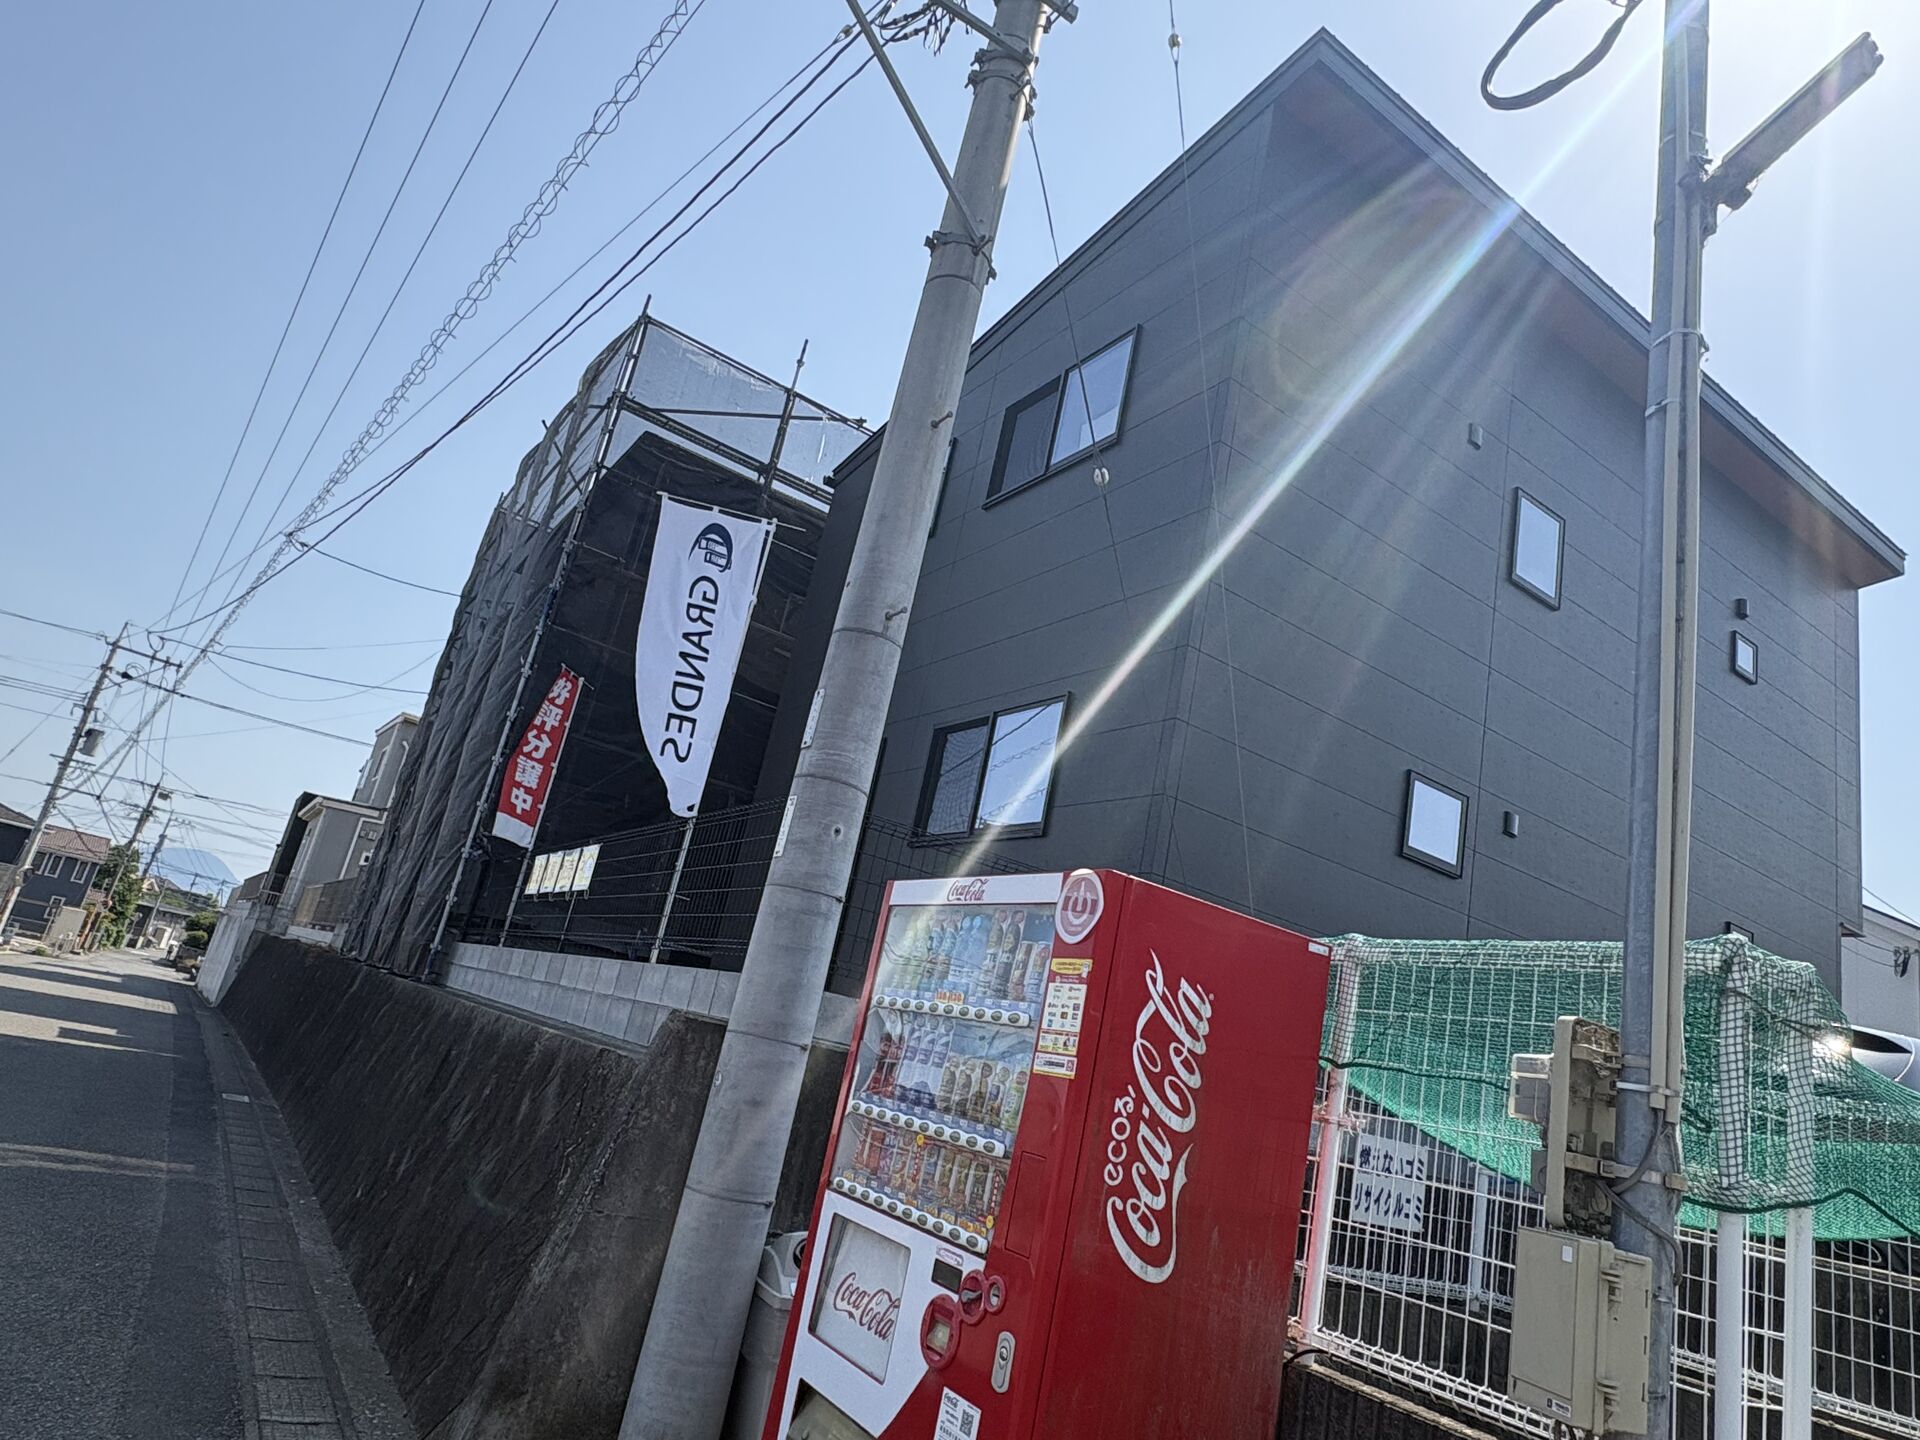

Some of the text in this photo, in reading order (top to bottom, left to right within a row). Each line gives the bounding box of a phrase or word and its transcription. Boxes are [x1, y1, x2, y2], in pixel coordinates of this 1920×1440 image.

[510, 676, 573, 815] 好評分譲中
